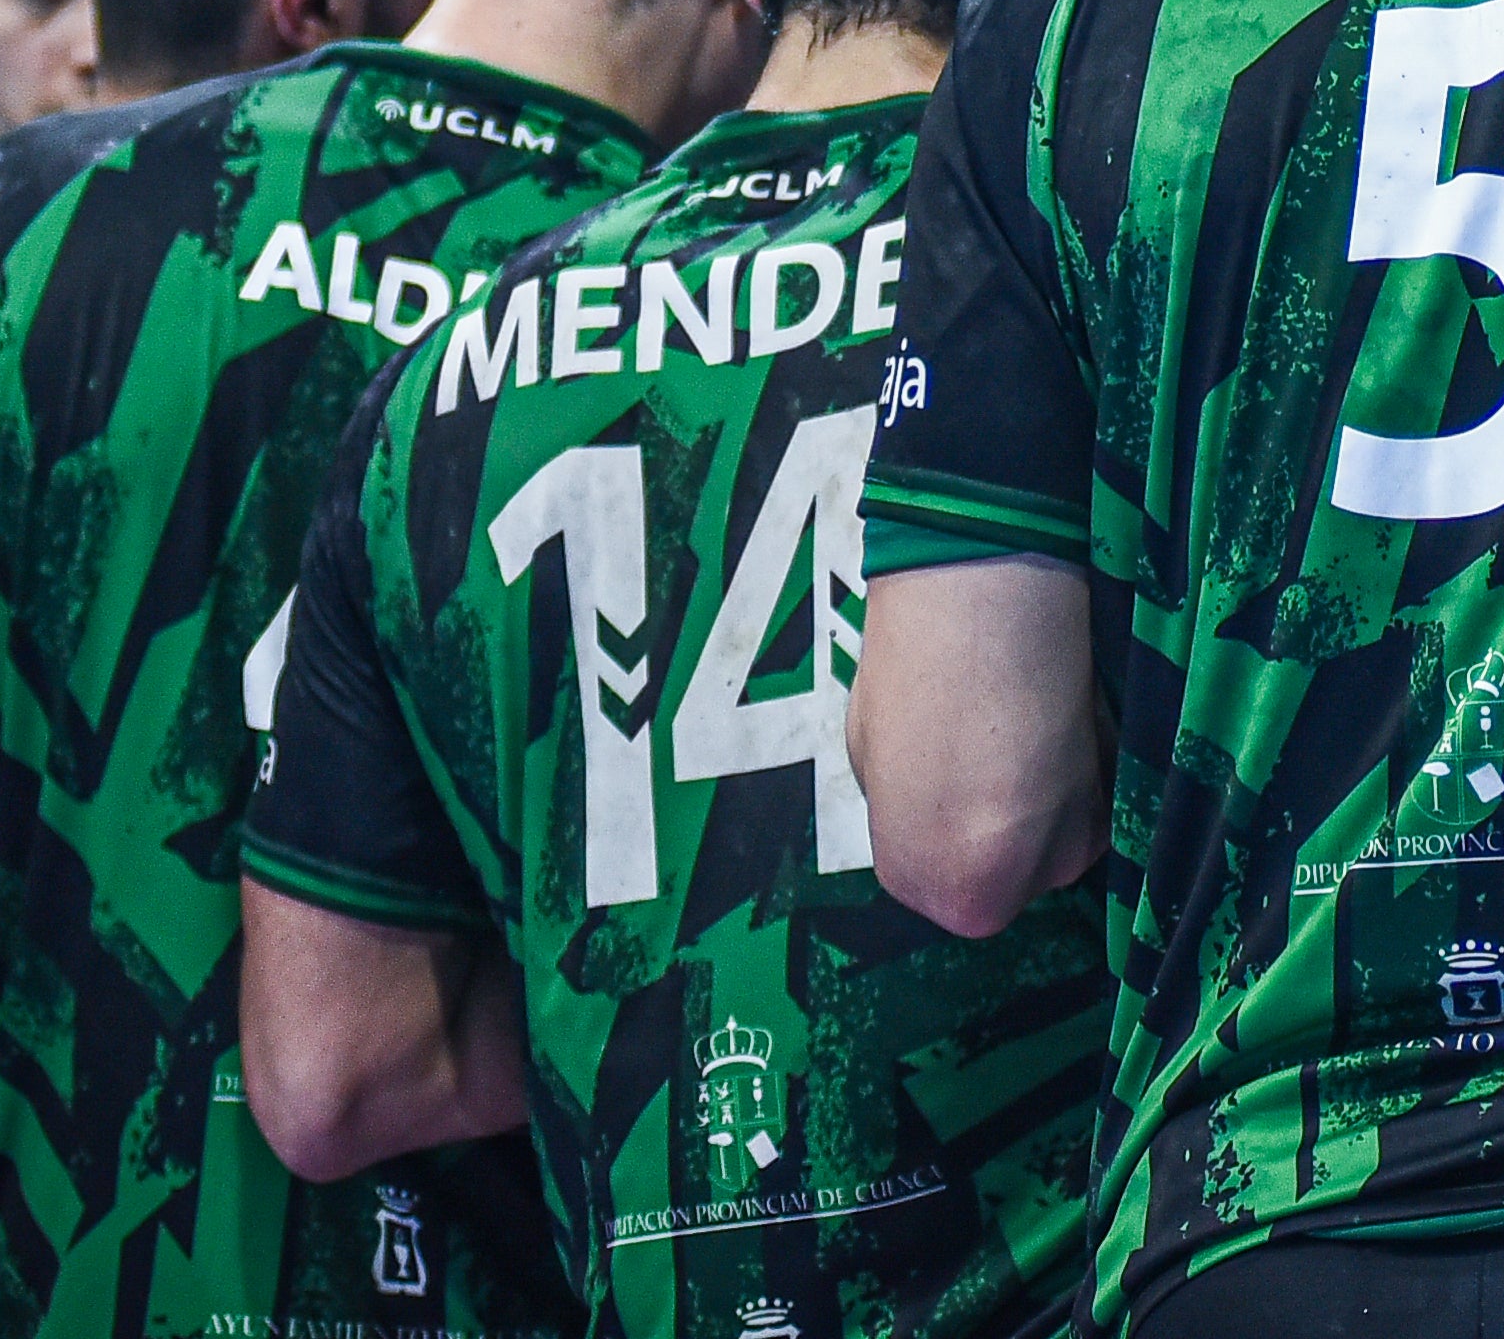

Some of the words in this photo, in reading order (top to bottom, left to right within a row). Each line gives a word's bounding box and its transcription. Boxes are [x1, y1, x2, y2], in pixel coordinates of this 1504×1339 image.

[409, 102, 556, 156] UCLM
[238, 219, 488, 348] ALD
[486, 403, 879, 909] 14
[817, 1188, 848, 1209] DE
